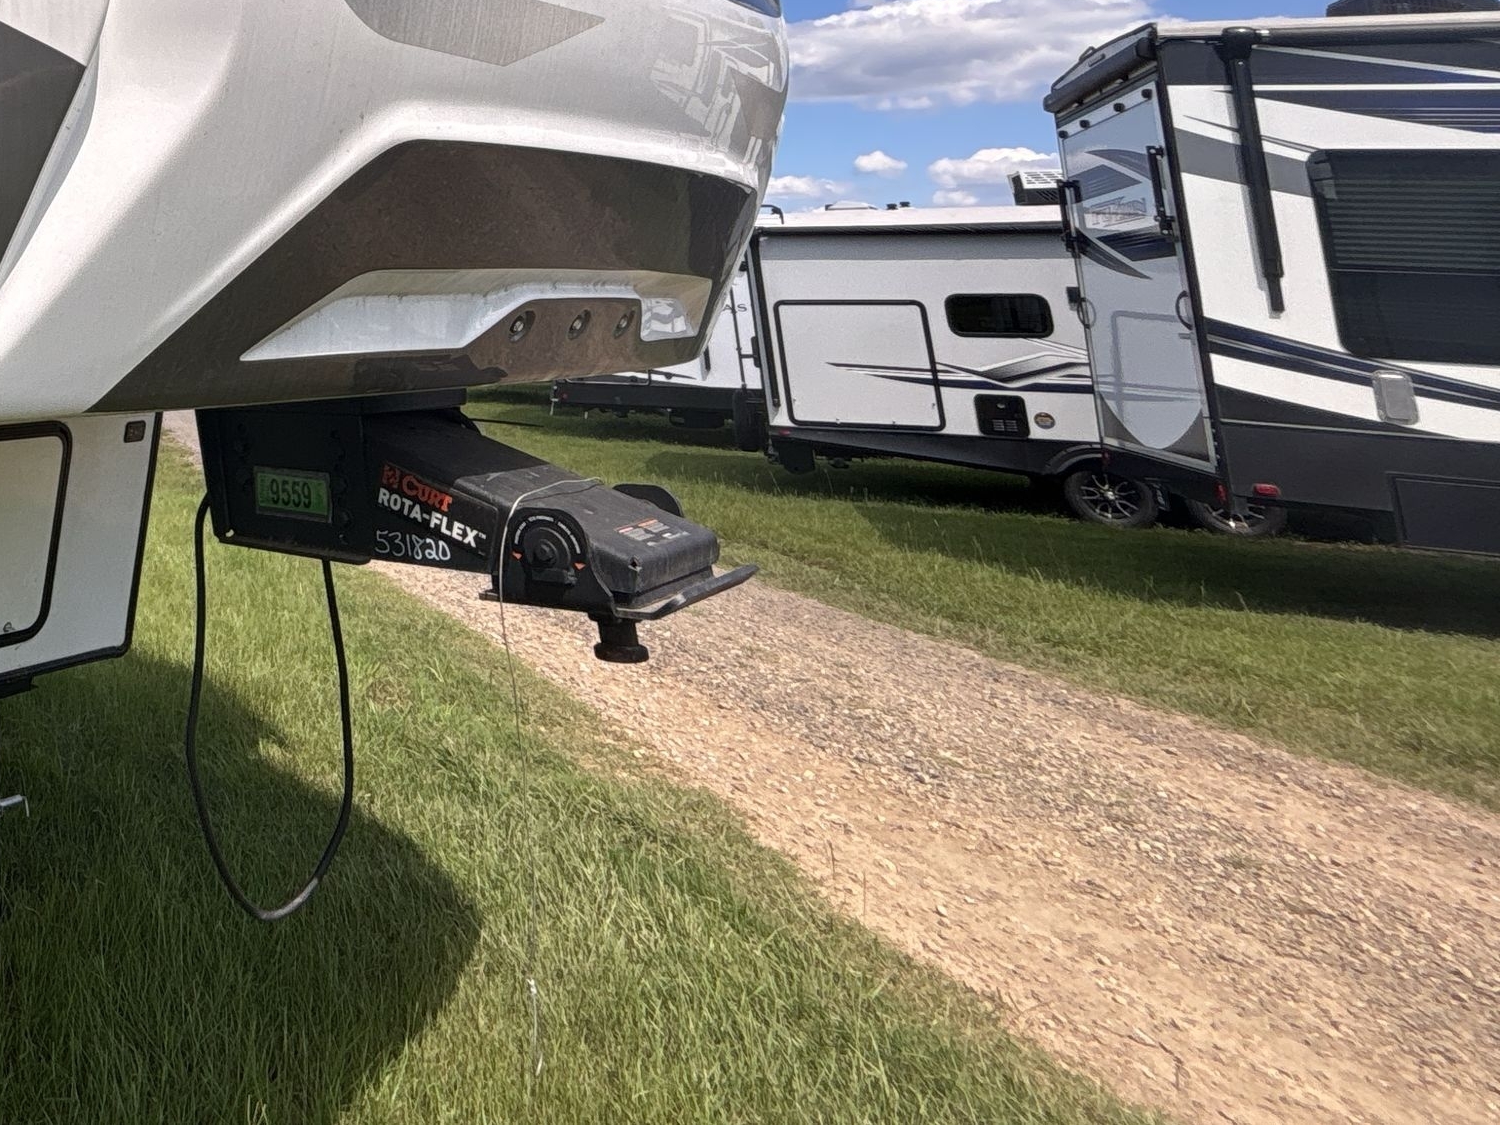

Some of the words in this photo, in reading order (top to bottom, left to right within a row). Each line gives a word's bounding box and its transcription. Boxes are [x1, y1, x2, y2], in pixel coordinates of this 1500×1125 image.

[722, 303, 748, 313] AS
[270, 478, 312, 509] 9559
[402, 474, 453, 512] CURT
[375, 530, 451, 561] 531820
